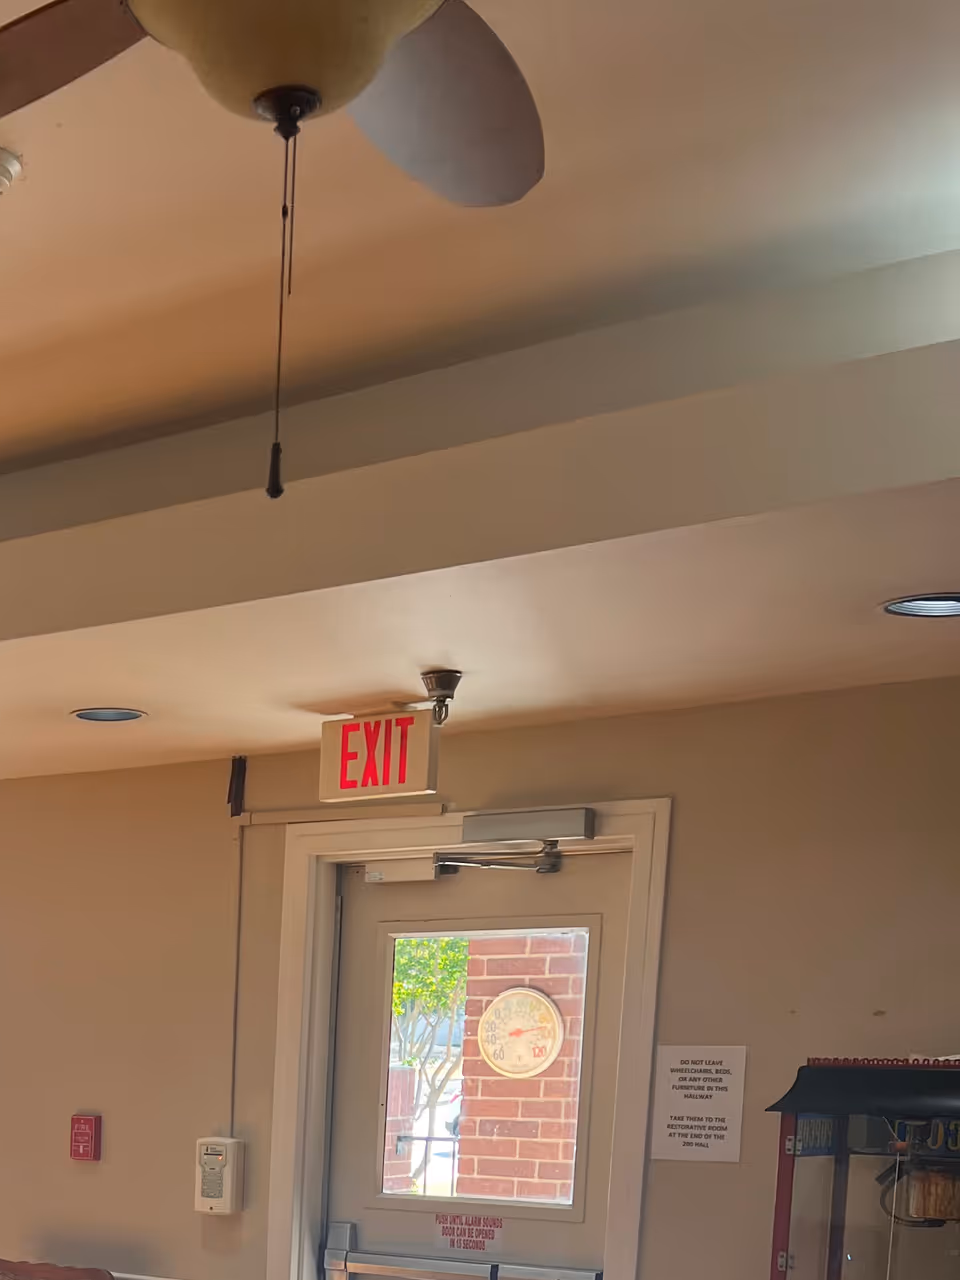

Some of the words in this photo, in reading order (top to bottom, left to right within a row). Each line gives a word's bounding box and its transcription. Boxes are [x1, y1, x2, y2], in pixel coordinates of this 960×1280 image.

[340, 716, 415, 790] EXIT
[493, 1048, 504, 1061] 60
[532, 1045, 547, 1058] 120
[702, 1076, 723, 1084] OTHER
[672, 1084, 705, 1092] FURNITURE
[666, 1123, 707, 1131] RESTORATIVE
[694, 1141, 710, 1149] HALL
[436, 1213, 448, 1224] PUSH
[449, 1215, 464, 1226] UNTIL
[465, 1216, 482, 1227] ALARM
[482, 1216, 503, 1228] SOUNDS
[442, 1225, 455, 1236] DOOR
[456, 1226, 467, 1237] CAN
[467, 1227, 475, 1239] BE
[475, 1227, 495, 1240] OPENED
[449, 1237, 456, 1249] IN
[462, 1239, 485, 1250] SECONDS
